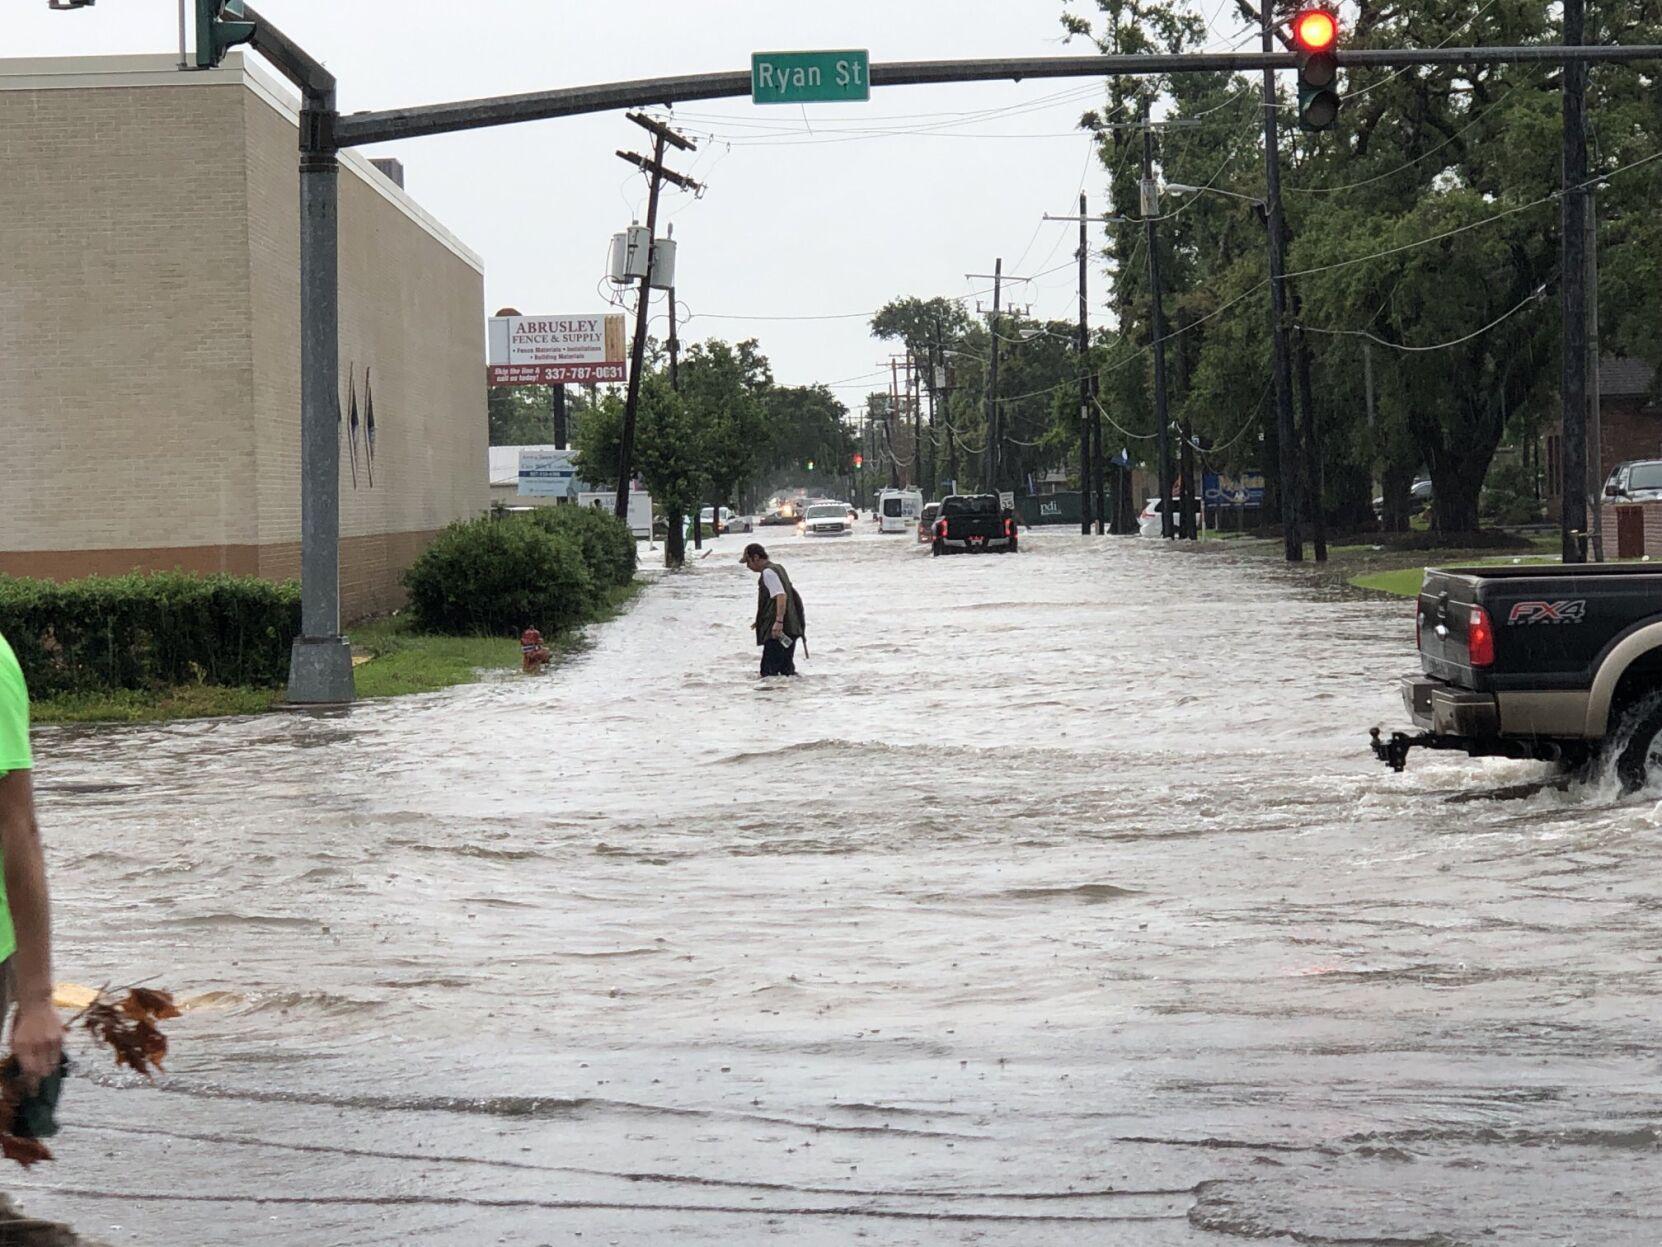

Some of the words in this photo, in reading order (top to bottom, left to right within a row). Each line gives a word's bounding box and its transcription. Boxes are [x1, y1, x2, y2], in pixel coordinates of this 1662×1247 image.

[759, 62, 821, 93] Ryan
[835, 60, 862, 86] St
[516, 320, 598, 334] ABRUSLEY
[512, 334, 549, 344] FENCE
[551, 334, 560, 343] &
[562, 333, 602, 342] SUPPLY
[1508, 600, 1587, 621] FX4
